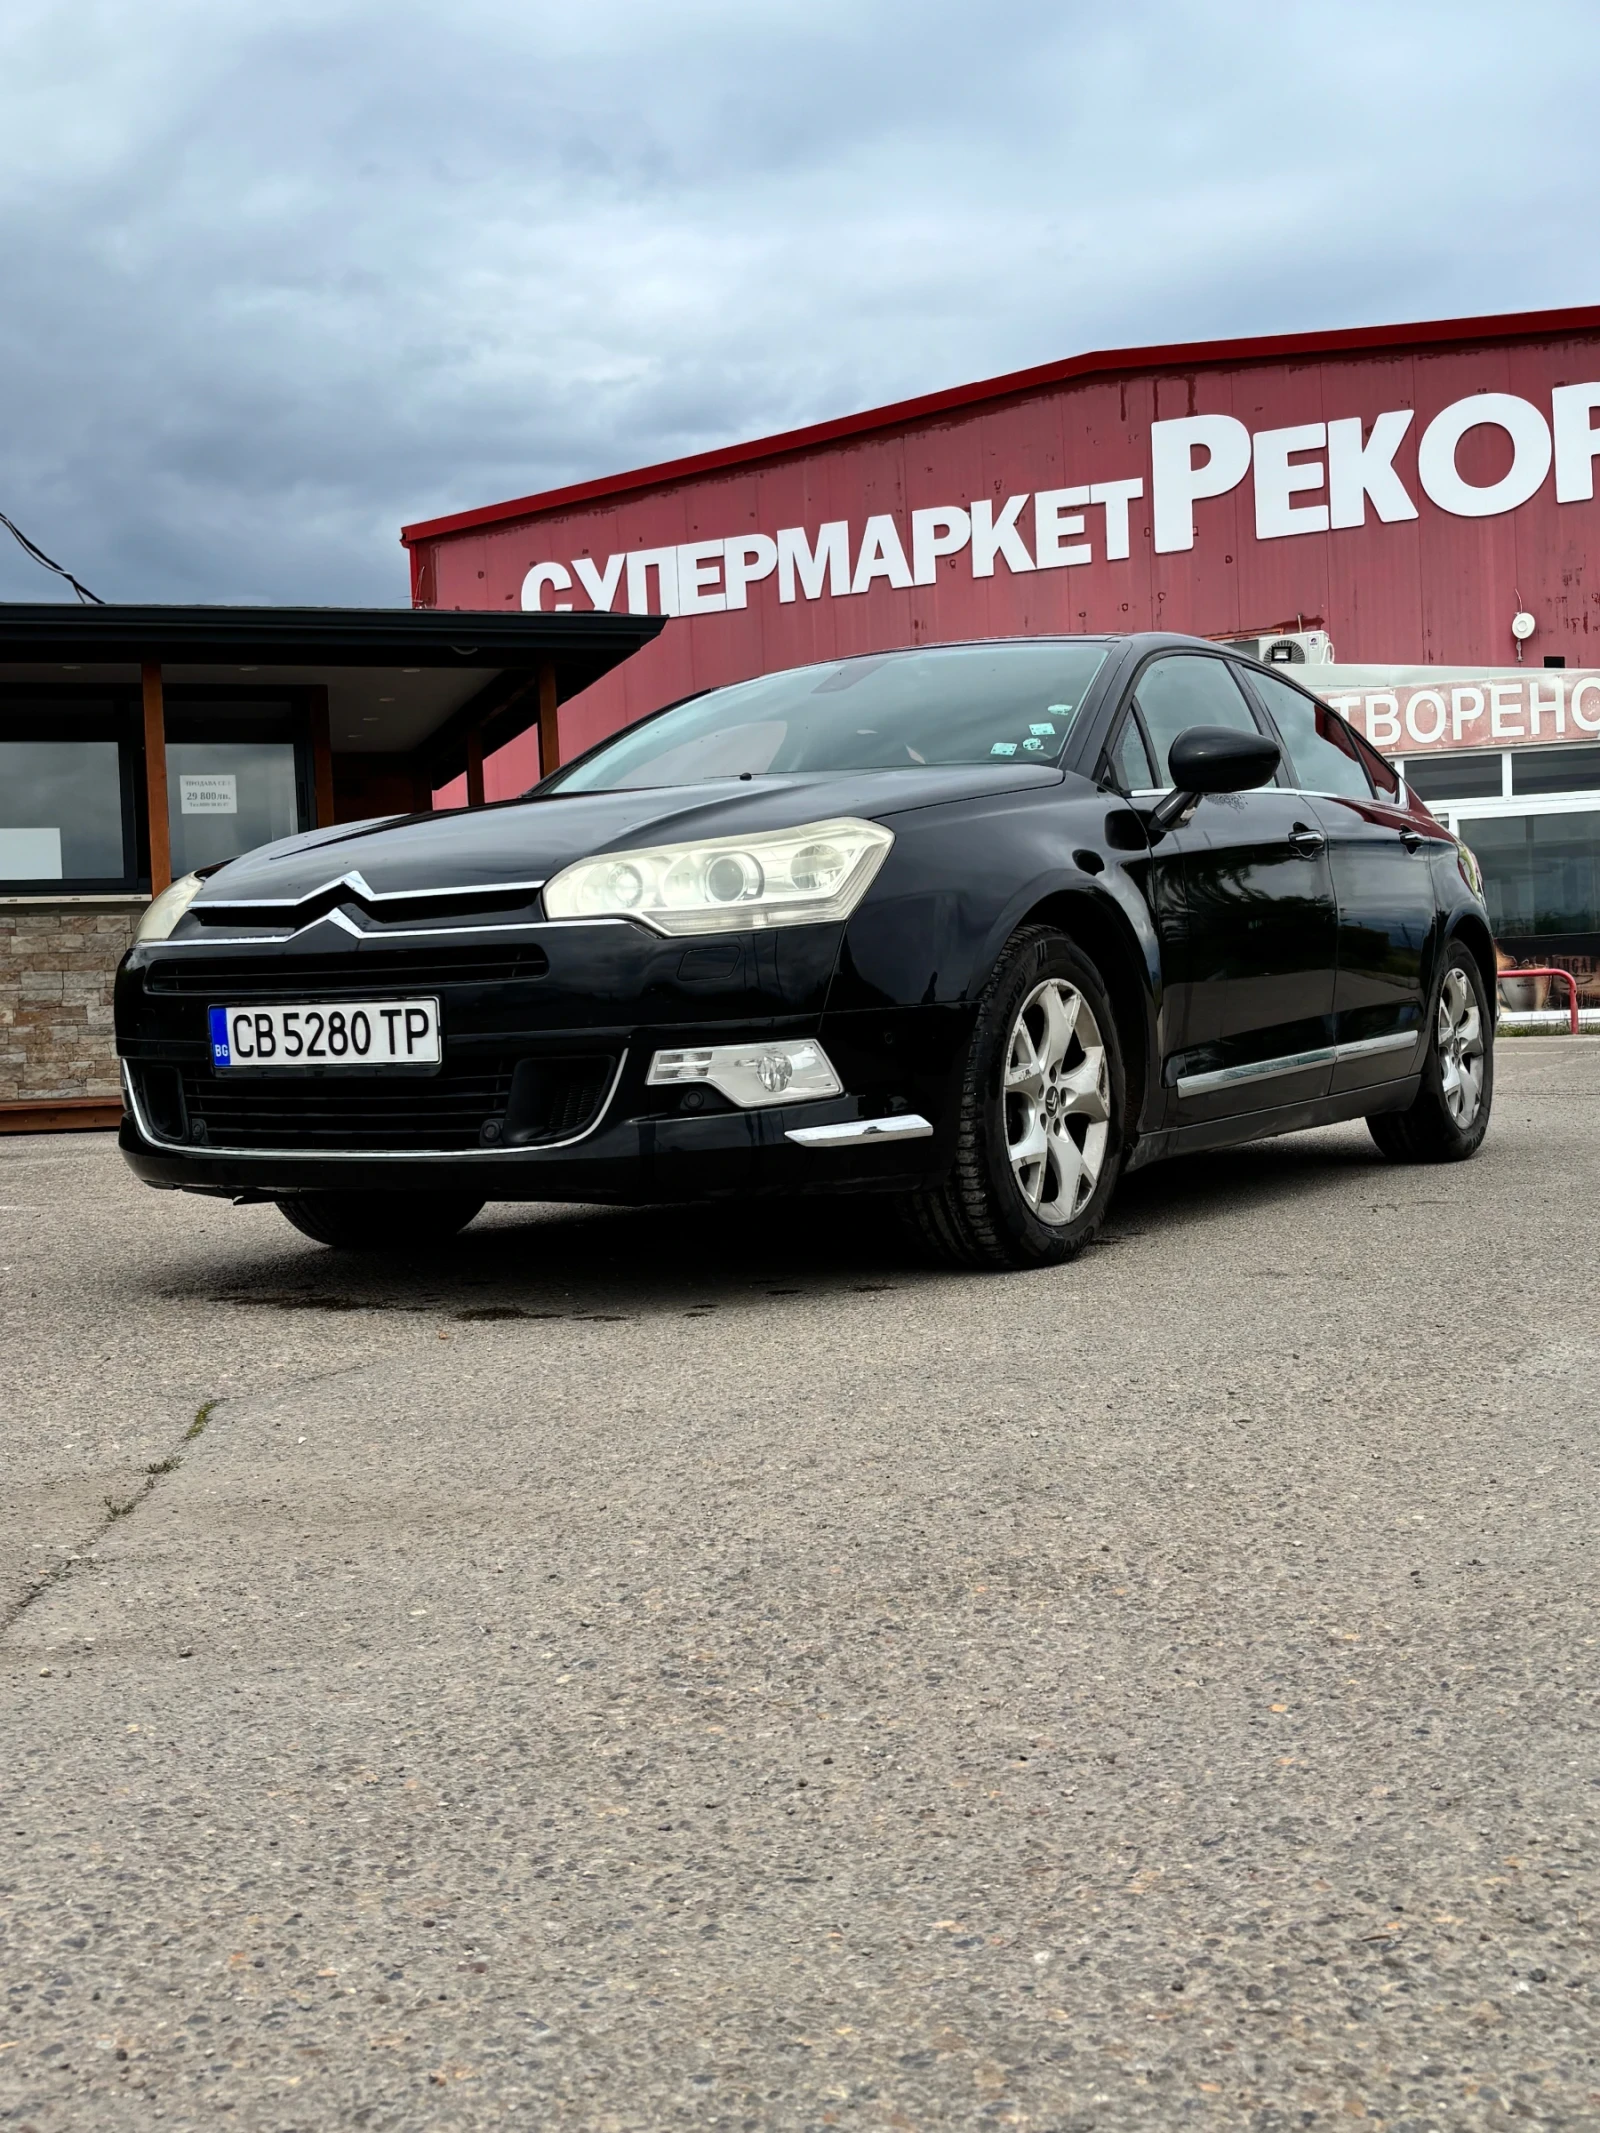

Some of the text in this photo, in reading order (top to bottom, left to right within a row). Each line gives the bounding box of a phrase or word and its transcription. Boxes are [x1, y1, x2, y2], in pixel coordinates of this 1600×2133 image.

[520, 477, 1144, 618] СУПЕРМАРКЕТ
[186, 792, 198, 801] 29
[233, 1008, 430, 1058] CB 5280 TP
[215, 1044, 229, 1058] BG
